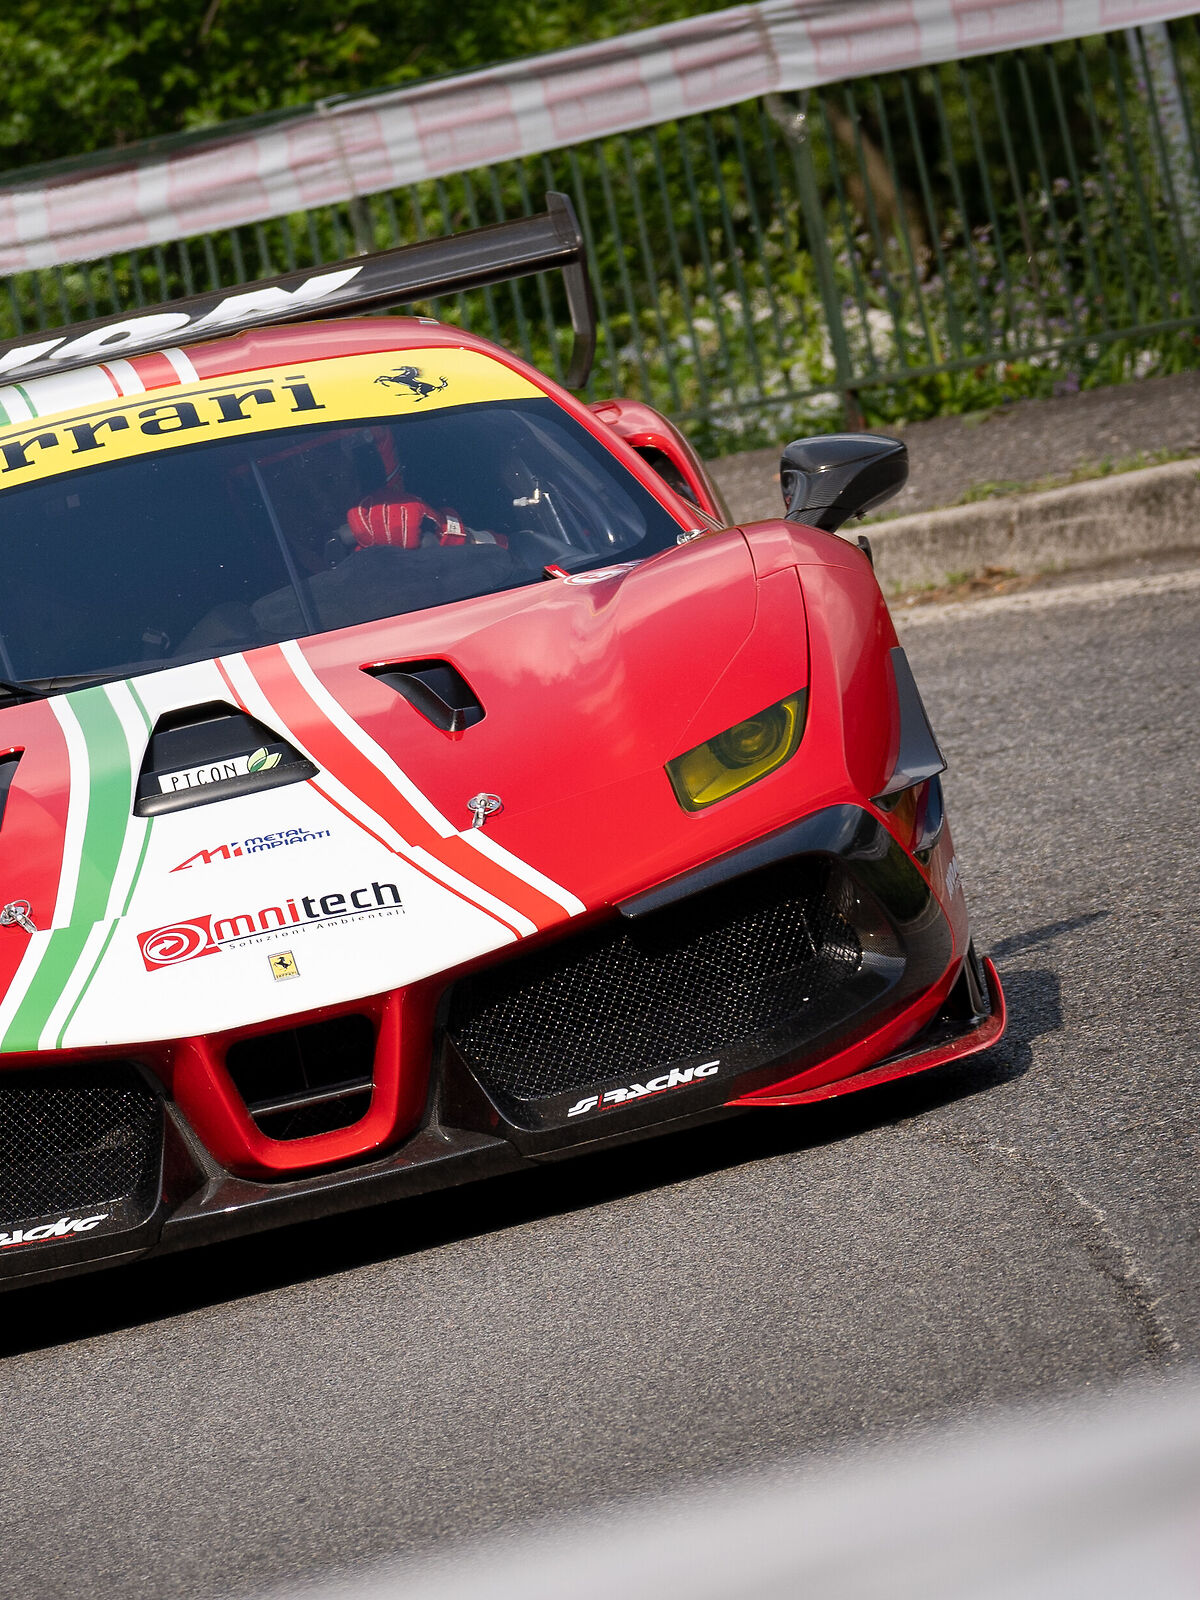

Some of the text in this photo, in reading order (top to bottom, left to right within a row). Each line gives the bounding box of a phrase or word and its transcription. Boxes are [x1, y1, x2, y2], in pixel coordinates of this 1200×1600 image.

[245, 828, 310, 846] METAL
[247, 830, 331, 853] IMPIANTI
[228, 909, 406, 949] Soluzioni Ambientali
